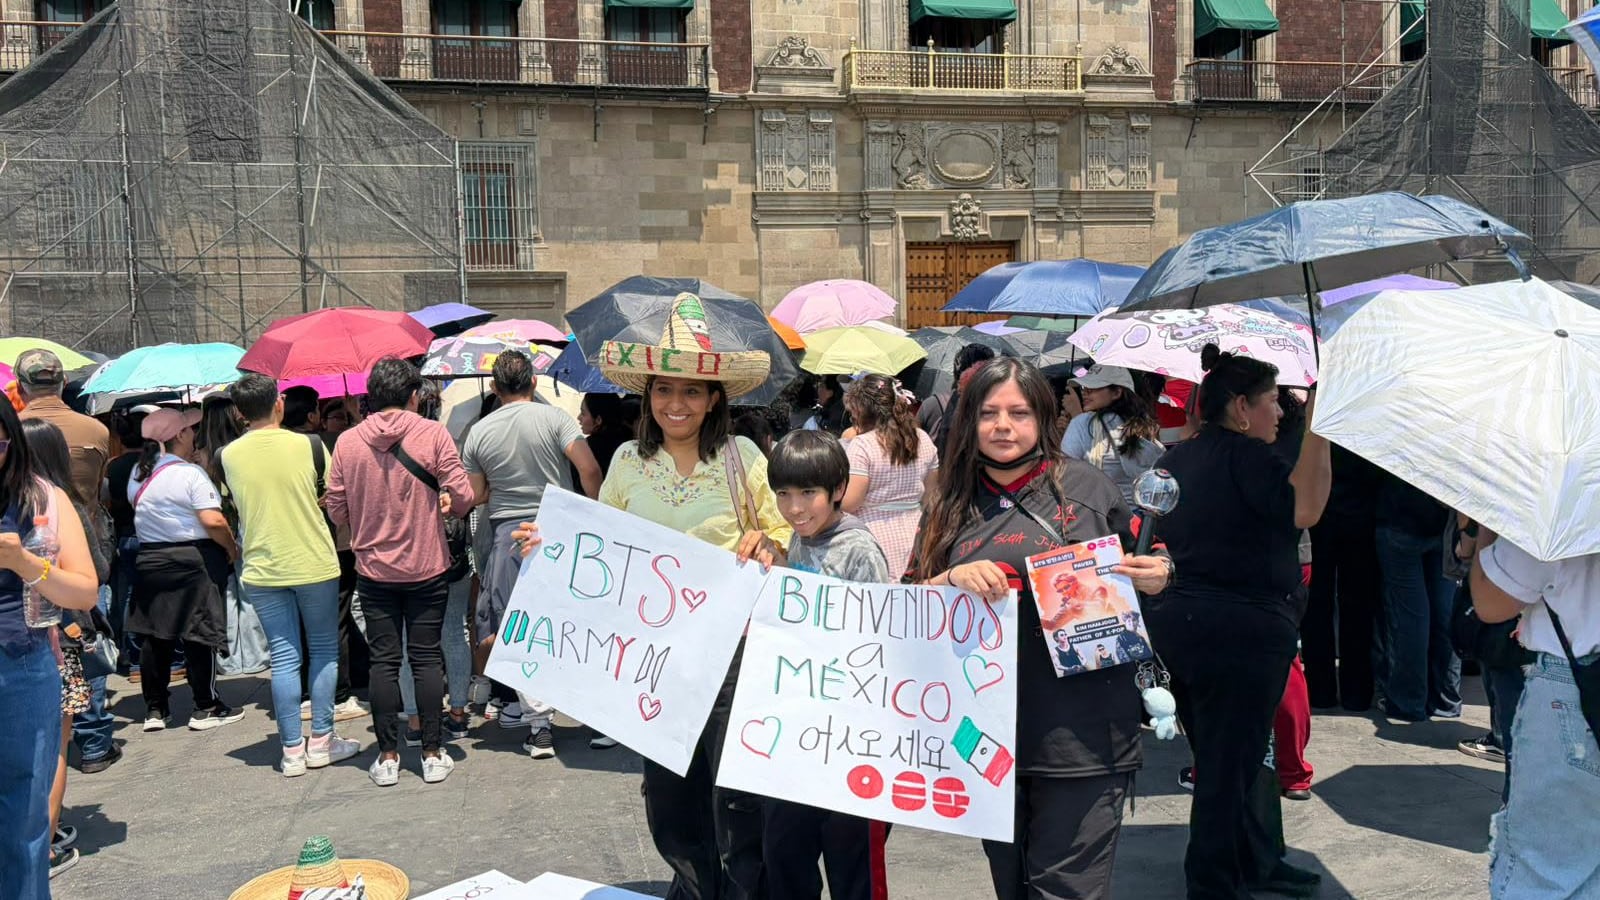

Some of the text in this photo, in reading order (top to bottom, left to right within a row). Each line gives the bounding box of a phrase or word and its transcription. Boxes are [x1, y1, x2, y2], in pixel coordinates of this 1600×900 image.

[569, 531, 681, 628] BTS
[1074, 560, 1094, 569] PAVED
[1097, 567, 1109, 575] THE
[778, 575, 1003, 650] BIENVENIDOS
[1069, 634, 1092, 644] FATHER
[527, 615, 636, 681] ARMY
[775, 656, 951, 723] MÉXICO
